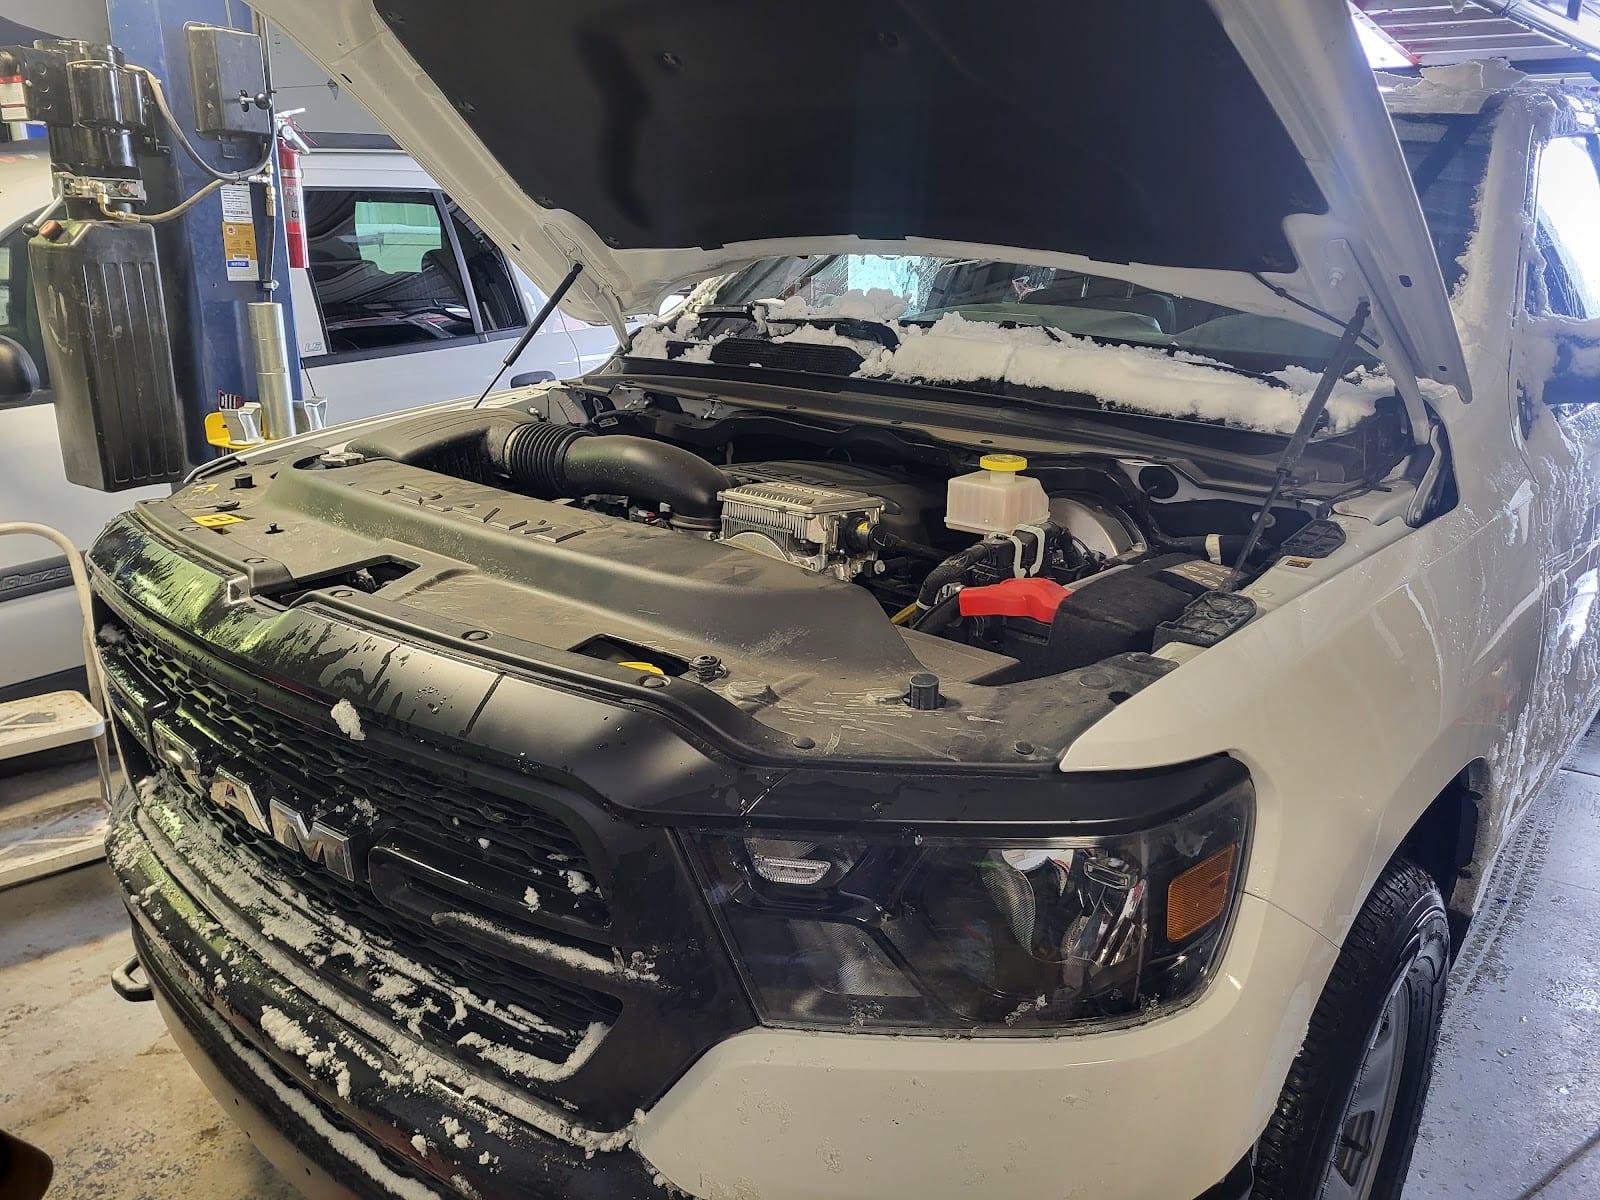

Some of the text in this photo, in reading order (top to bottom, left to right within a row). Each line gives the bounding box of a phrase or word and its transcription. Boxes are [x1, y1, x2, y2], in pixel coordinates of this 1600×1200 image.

[365, 478, 588, 543] RAM
[2, 565, 71, 590] BLAZE
[152, 718, 355, 882] RAM
